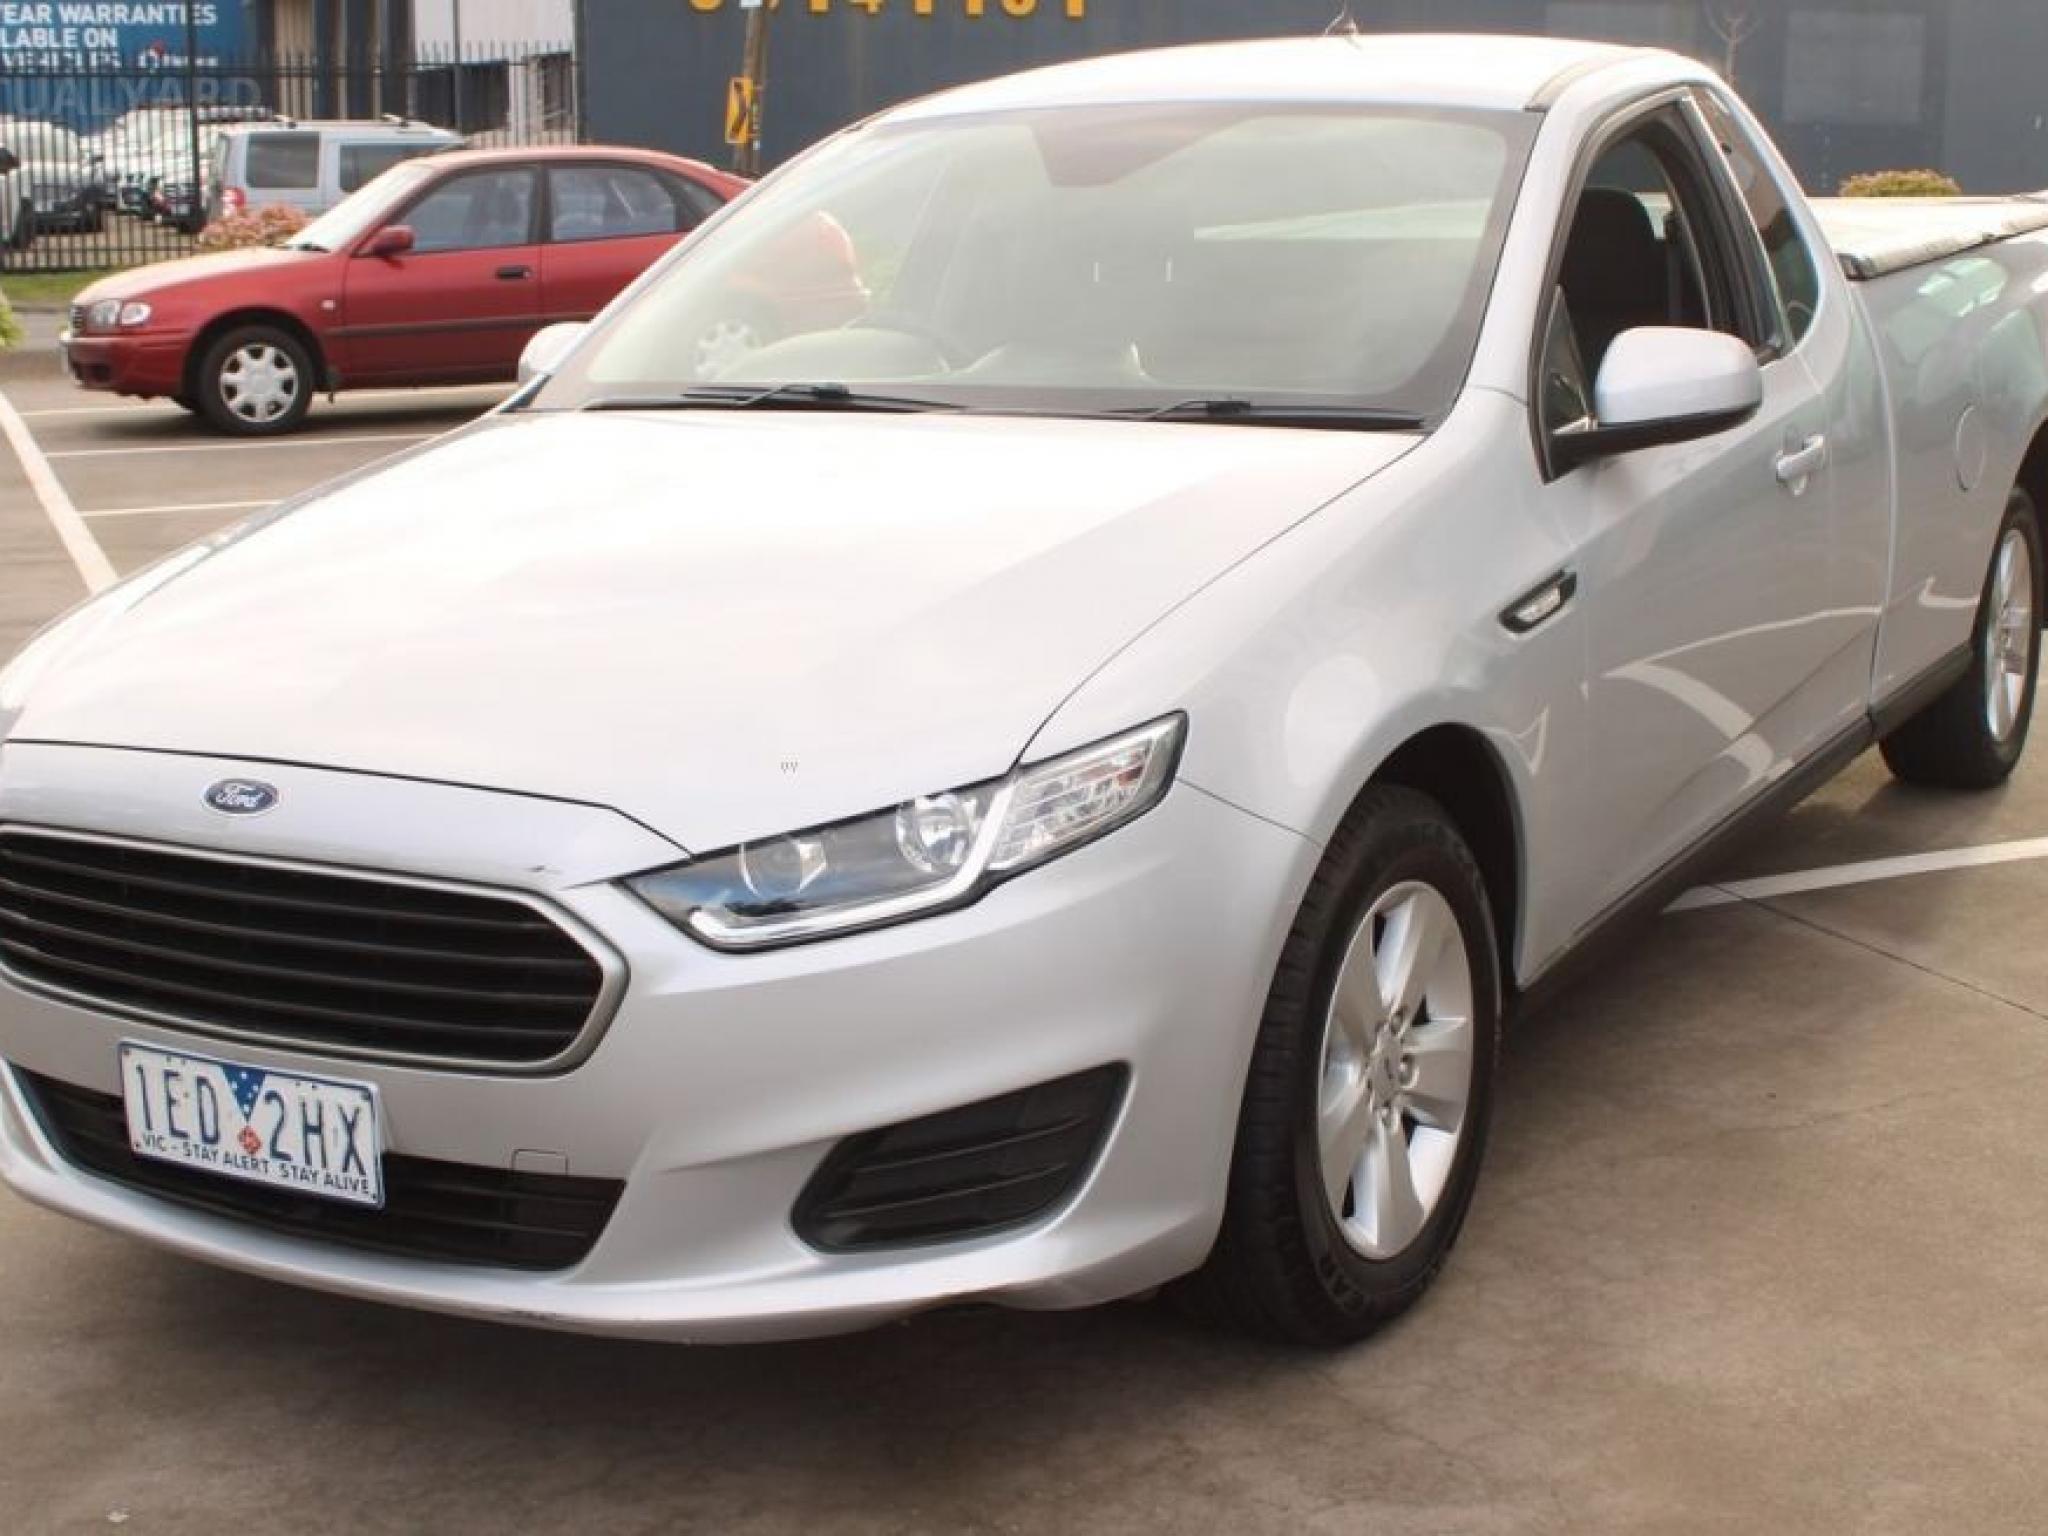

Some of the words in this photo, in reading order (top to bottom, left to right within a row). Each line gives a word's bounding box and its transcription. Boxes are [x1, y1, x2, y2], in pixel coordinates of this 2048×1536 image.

[59, 4, 217, 25] WARRANTIES
[84, 28, 118, 48] ON
[215, 782, 264, 807] Ford
[136, 1064, 220, 1145] 1ED
[264, 1090, 367, 1176] 2HX
[183, 1141, 218, 1163] STAY
[223, 1152, 269, 1174] ALERT
[280, 1163, 319, 1184] STAY
[323, 1173, 369, 1195] ALIVE
